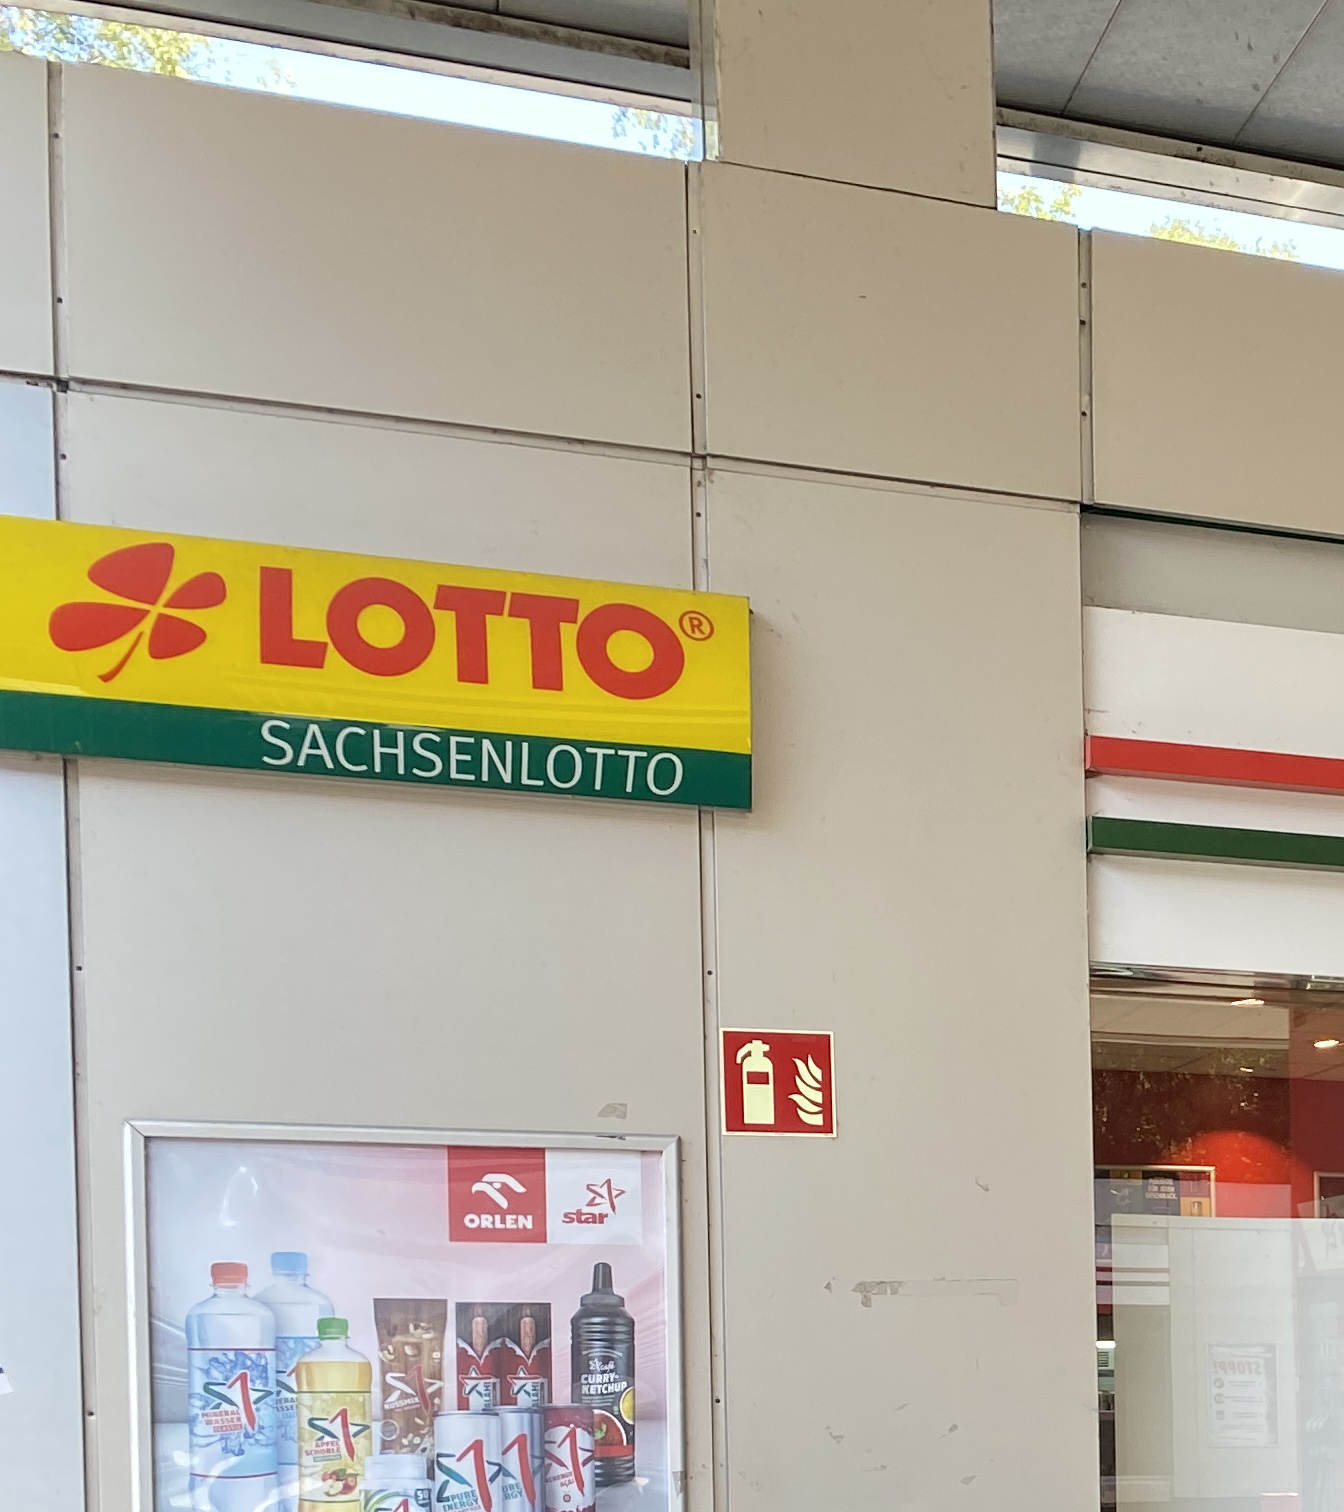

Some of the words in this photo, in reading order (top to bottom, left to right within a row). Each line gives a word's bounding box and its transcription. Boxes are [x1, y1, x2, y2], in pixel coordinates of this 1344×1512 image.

[261, 720, 683, 796] SACHSENLOTTO
[464, 1213, 532, 1229] ORLEN
[562, 1209, 608, 1225] star
[581, 1373, 619, 1384] CURRY-
[582, 1381, 627, 1394] KETCHUP
[205, 1416, 242, 1426] WASSER
[450, 1489, 476, 1501] PURE
[443, 1497, 479, 1512] ENERGY
